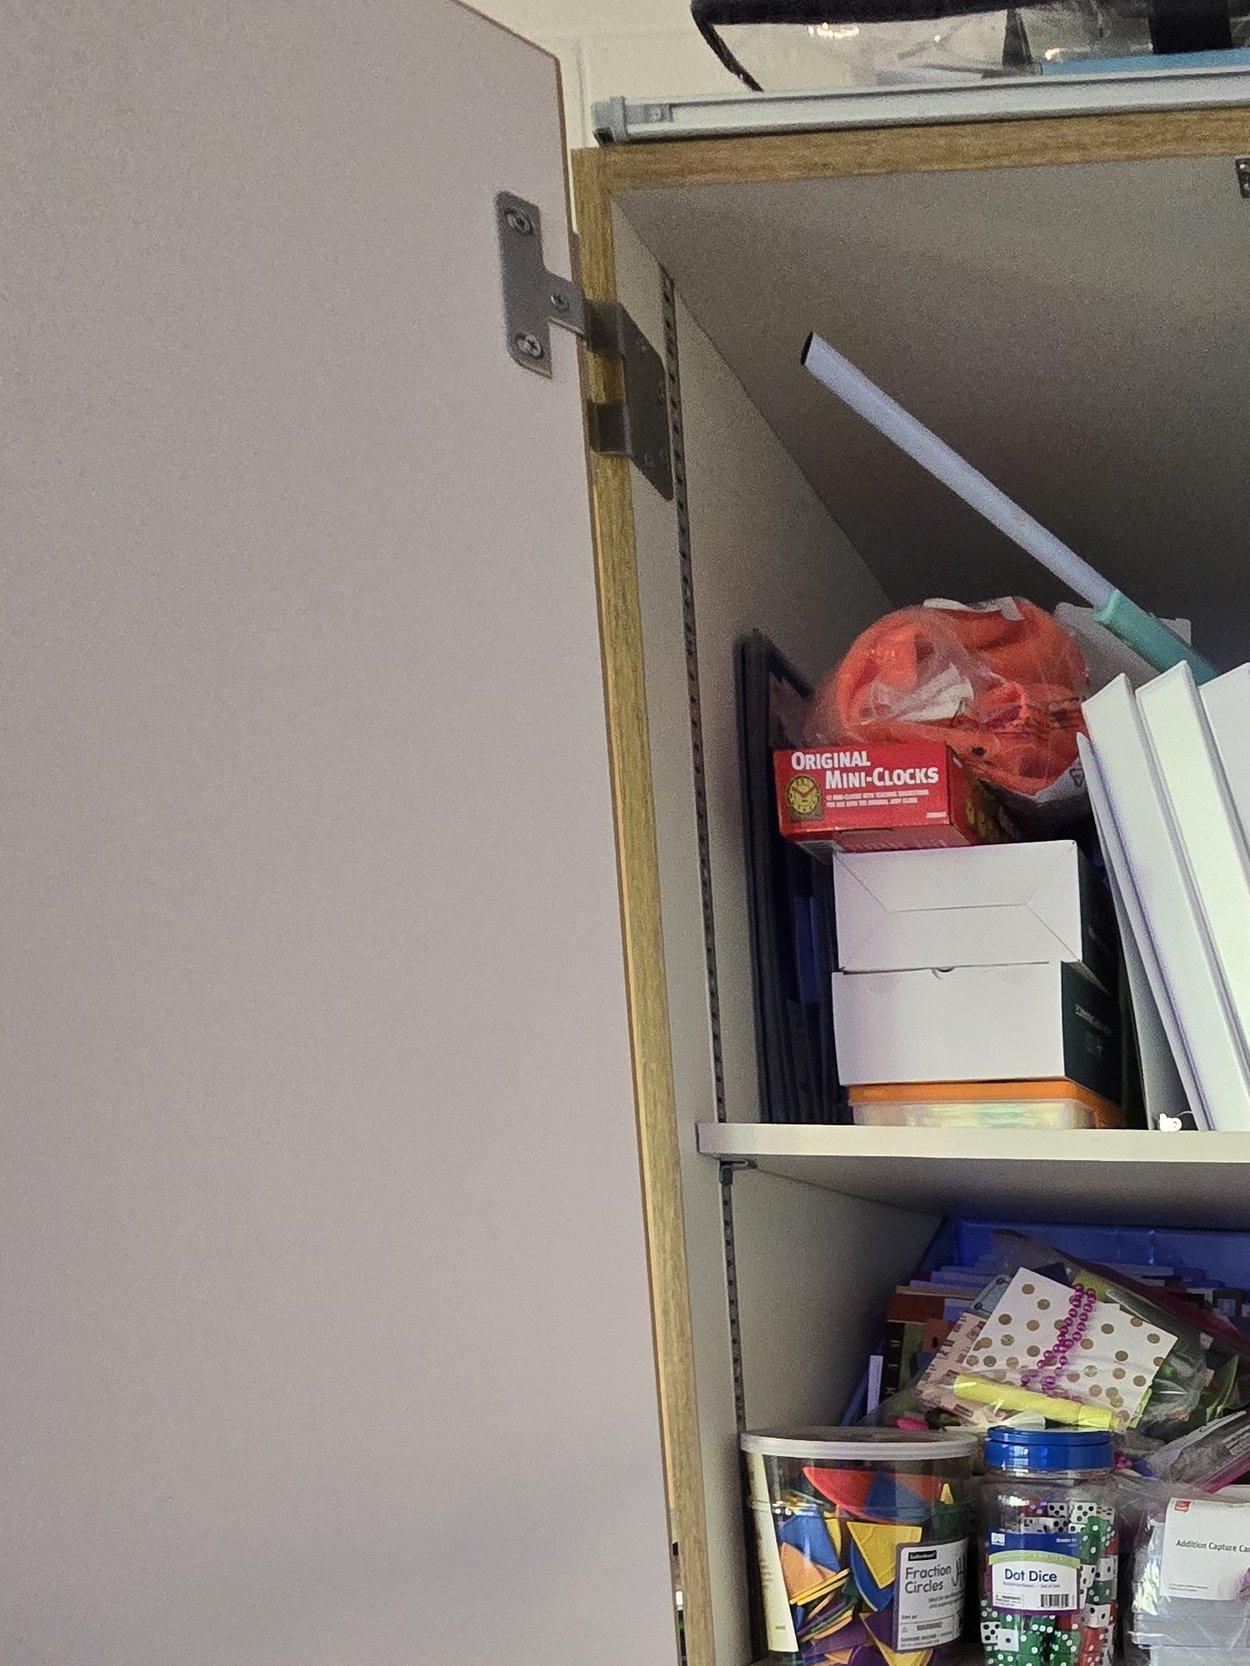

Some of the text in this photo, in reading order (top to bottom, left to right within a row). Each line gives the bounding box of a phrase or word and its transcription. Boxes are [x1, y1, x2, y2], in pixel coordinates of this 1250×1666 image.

[791, 751, 871, 771] ORIGINAL
[825, 767, 939, 790] MINI-CLOCKS
[1176, 1539, 1207, 1549] Addition
[1208, 1541, 1237, 1552] Capture
[905, 1564, 952, 1580] Fraction
[1004, 1568, 1057, 1582] Dot Dice
[905, 1580, 944, 1594] Circles
